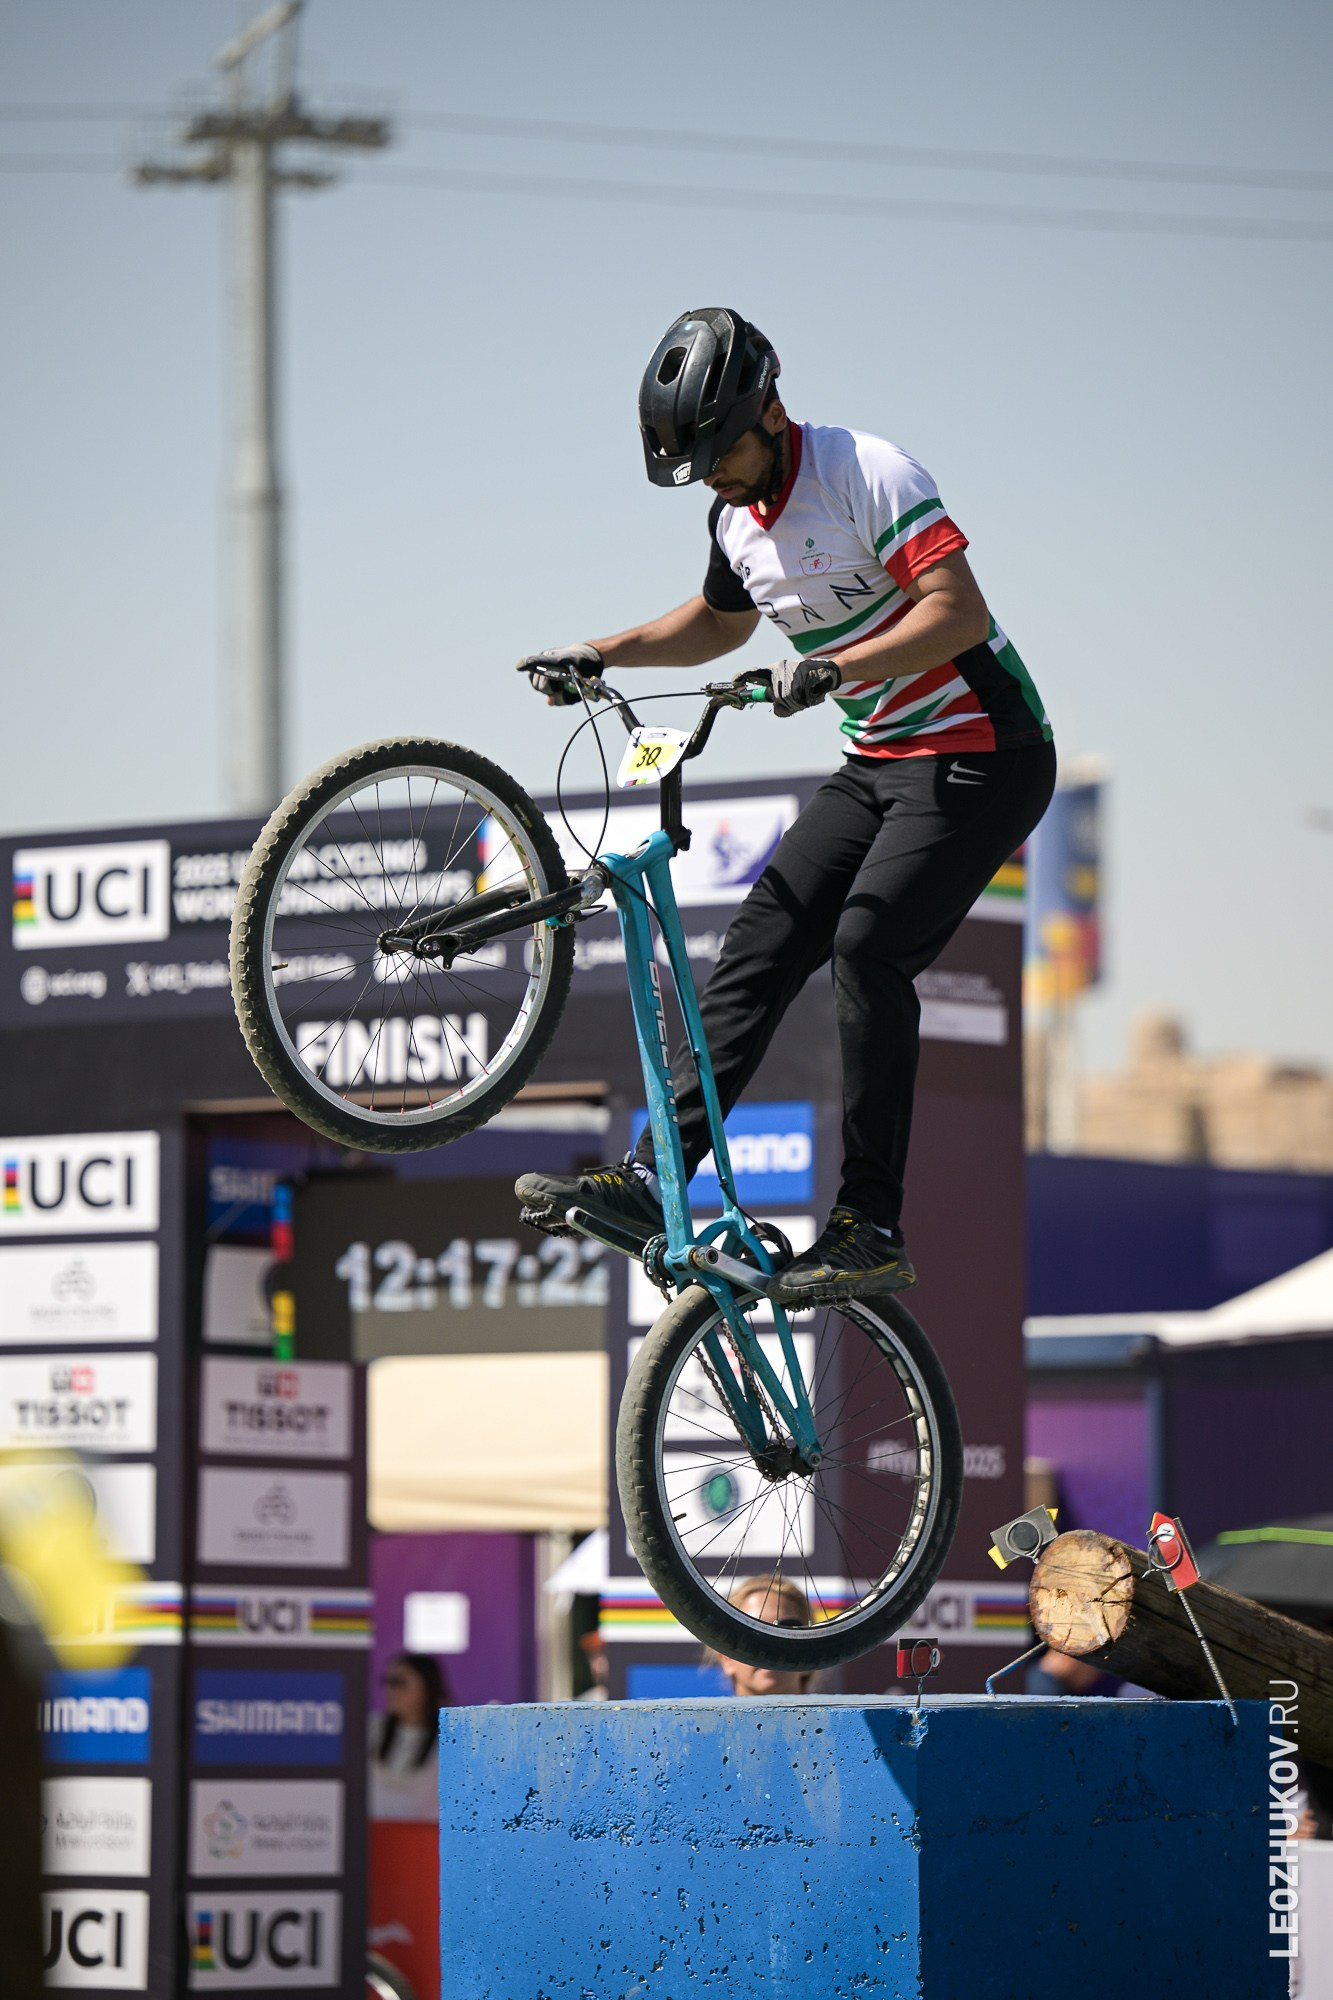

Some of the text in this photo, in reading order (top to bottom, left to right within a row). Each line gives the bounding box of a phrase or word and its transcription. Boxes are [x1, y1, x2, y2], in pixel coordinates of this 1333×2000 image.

[636, 747, 662, 767] 30
[46, 867, 150, 922] UCI
[296, 1012, 488, 1088] FINISH
[29, 1156, 135, 1210] UCI
[14, 1400, 131, 1428] TISSOT
[224, 1404, 330, 1433] TISSOT
[239, 1599, 300, 1633] UCI
[38, 1697, 149, 1733] IMANO
[197, 1699, 343, 1735] SHIMANO
[217, 1910, 323, 1969] UCI
